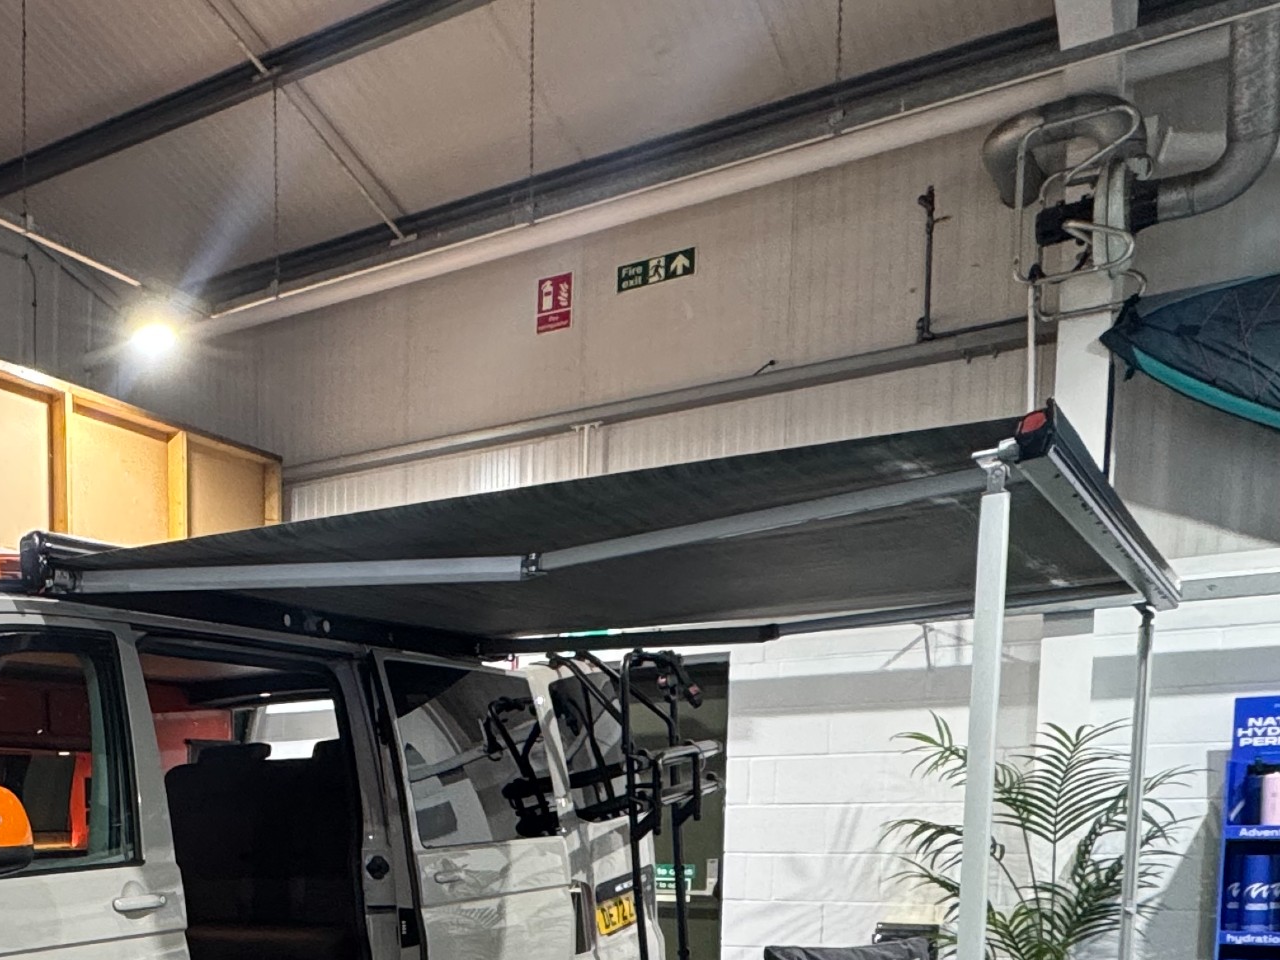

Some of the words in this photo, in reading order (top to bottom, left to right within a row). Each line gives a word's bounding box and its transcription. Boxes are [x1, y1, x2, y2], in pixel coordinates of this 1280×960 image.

[621, 265, 643, 277] Fire
[621, 275, 642, 289] exit
[1239, 737, 1280, 747] PER
[1239, 827, 1280, 837] Adven
